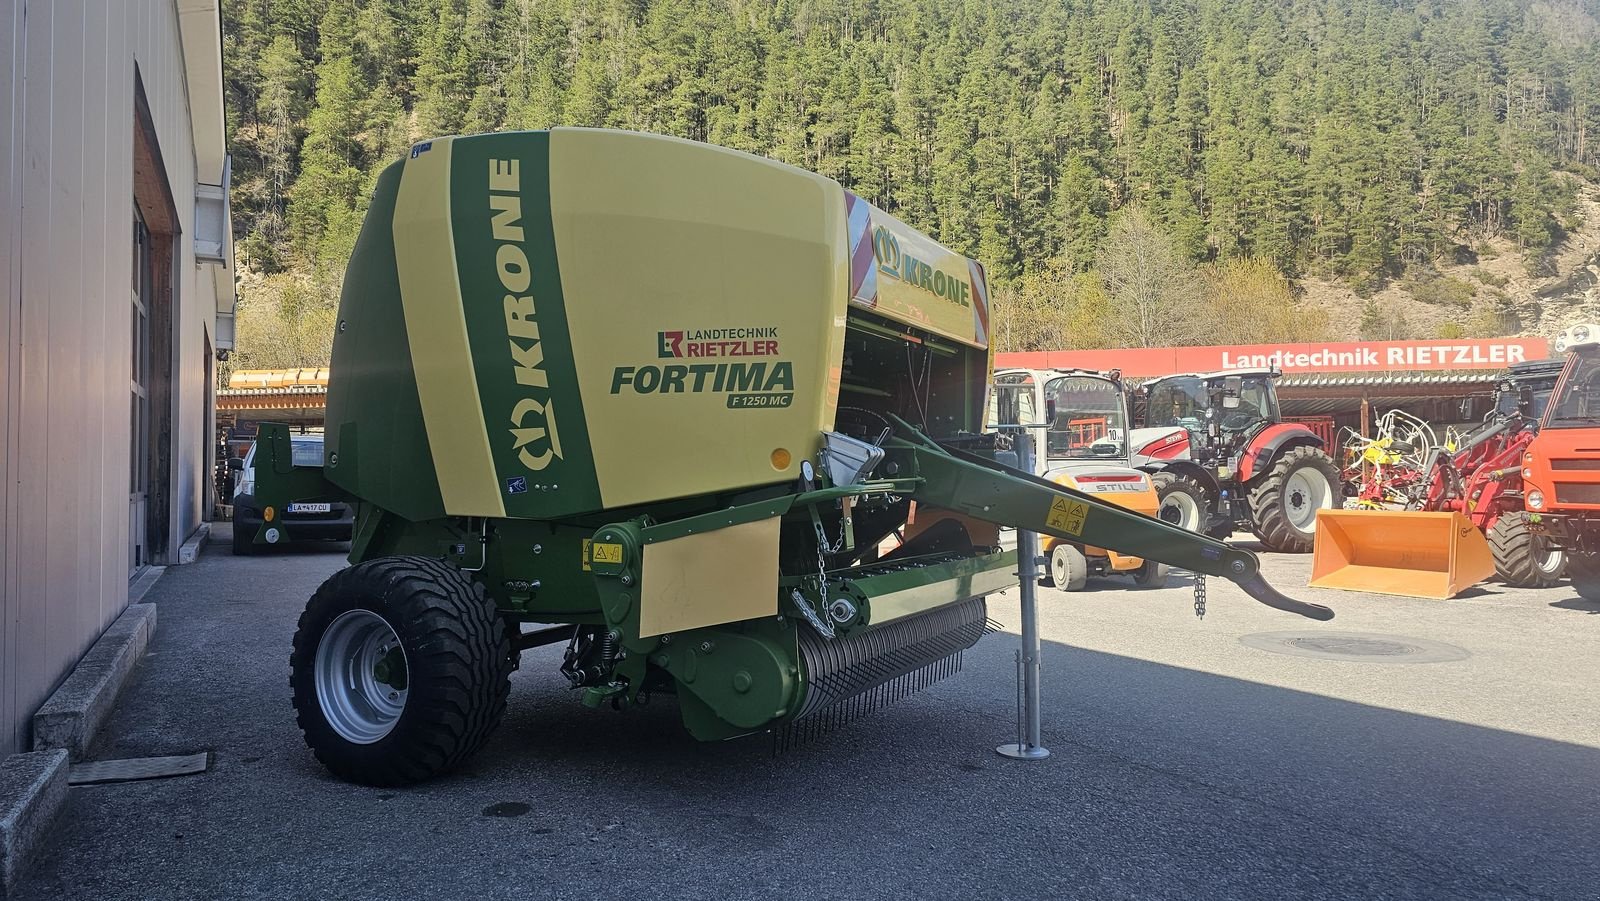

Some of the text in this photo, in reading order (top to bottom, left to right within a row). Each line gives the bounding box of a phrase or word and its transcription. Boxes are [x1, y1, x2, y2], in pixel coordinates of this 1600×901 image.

[489, 158, 549, 388] KRONE
[903, 253, 970, 308] KRONE
[687, 327, 778, 340] LANDTECHNIK
[687, 340, 779, 357] RIETZLER
[1222, 344, 1526, 369] Landtechnik RIETZLER
[610, 361, 795, 394] FORTIMA
[732, 395, 788, 406] F 1250 MC
[1108, 429, 1117, 440] 10
[1095, 483, 1139, 491] STILL
